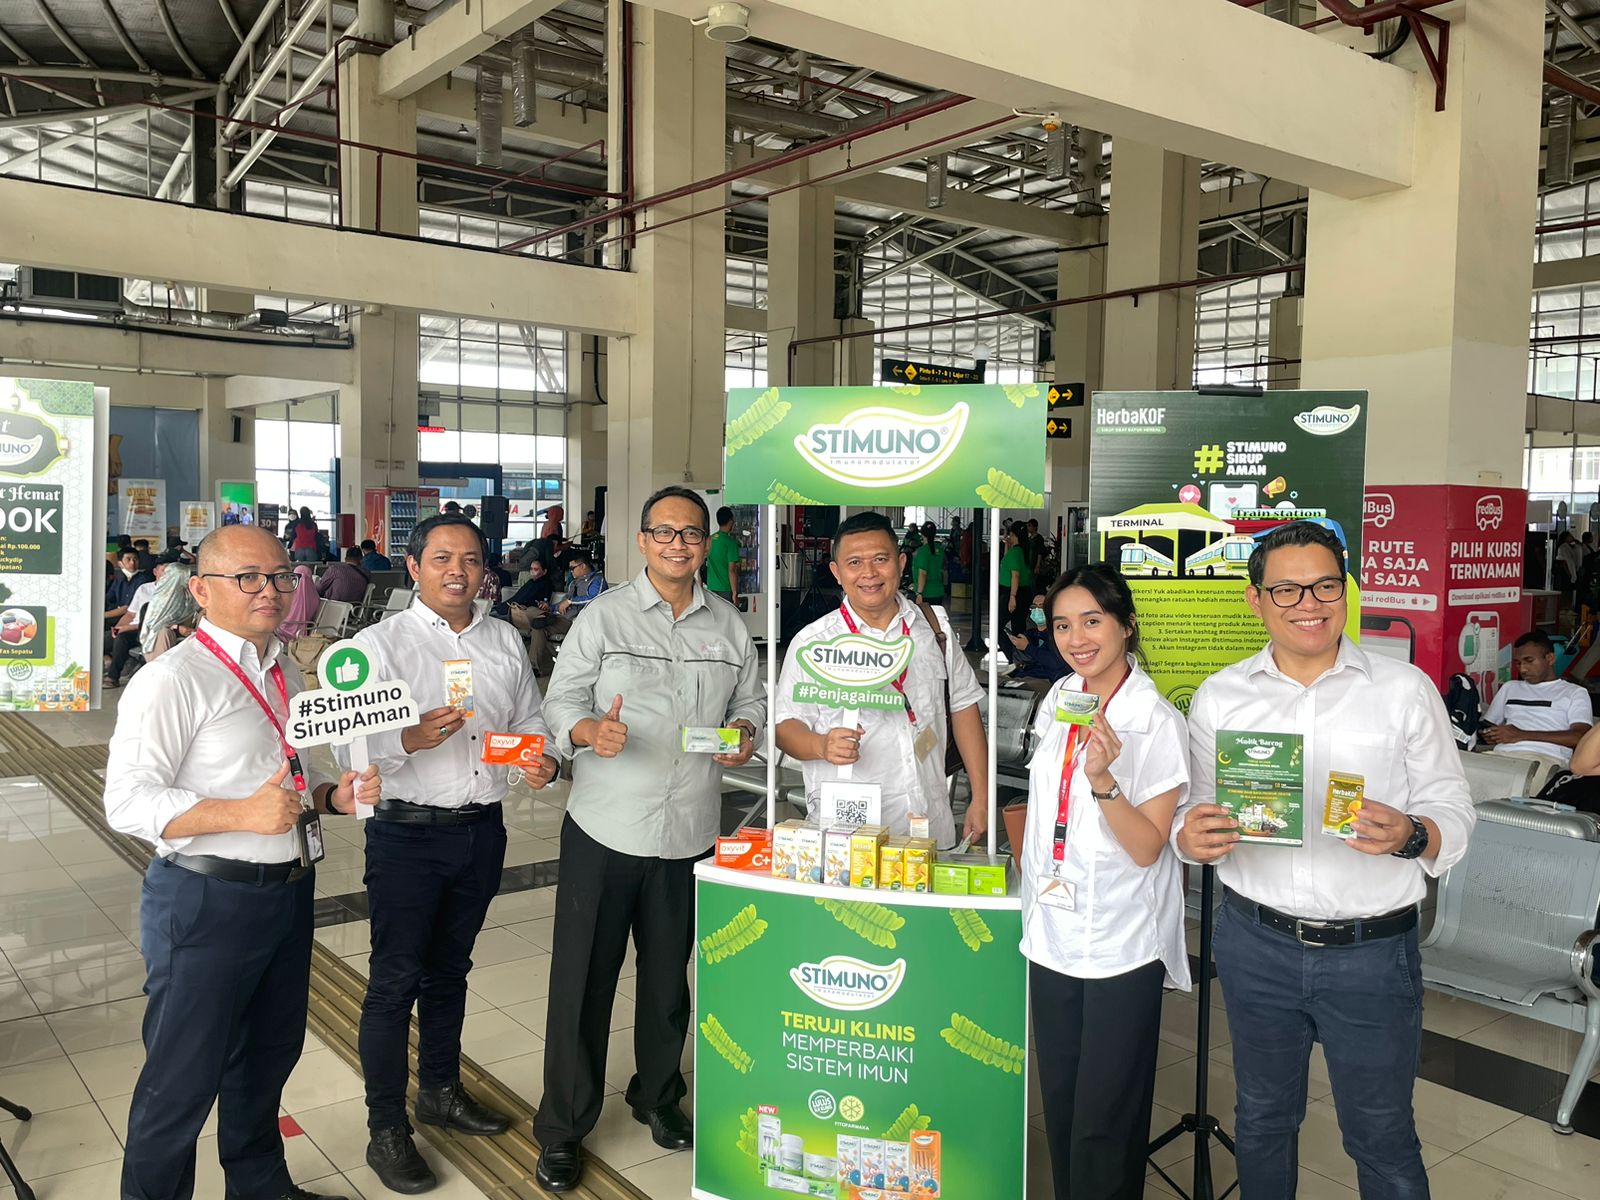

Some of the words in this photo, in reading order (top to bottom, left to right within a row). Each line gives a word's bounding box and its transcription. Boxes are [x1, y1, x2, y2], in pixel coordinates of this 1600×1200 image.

[1097, 408, 1166, 425] HerbaKOF
[1300, 413, 1350, 424] STIMUNO
[0, 443, 31, 454] UNO
[812, 429, 941, 454] STIMUNO
[1226, 441, 1287, 453] STIMUNO
[1226, 453, 1264, 464] SIRUP
[1225, 465, 1267, 476] AMAN
[1273, 509, 1322, 517] station
[1478, 503, 1502, 515] redBus
[0, 506, 57, 534] OK
[1111, 518, 1164, 527] TERMINAL
[1368, 541, 1415, 554] RUTE
[1451, 542, 1483, 558] PILIH
[1487, 542, 1521, 558] KURSI
[1383, 557, 1430, 571] SAJA
[1450, 562, 1520, 580] TERNYAMAN
[1374, 572, 1421, 587] SAJA
[1375, 596, 1406, 604] redBus
[813, 648, 893, 668] STIMUNO
[299, 686, 402, 718] #Stimuno
[799, 686, 903, 705] #Penjagaimun
[293, 705, 410, 739] SirupAman
[801, 966, 888, 991] STIMUNO
[781, 1011, 845, 1034] TERUJI
[850, 1021, 916, 1042] KLINIS
[782, 1031, 914, 1063] MEMPERBAIKI
[786, 1052, 852, 1078] SISTEM
[858, 1063, 908, 1084] IMUN
[758, 1105, 776, 1114] NEW
